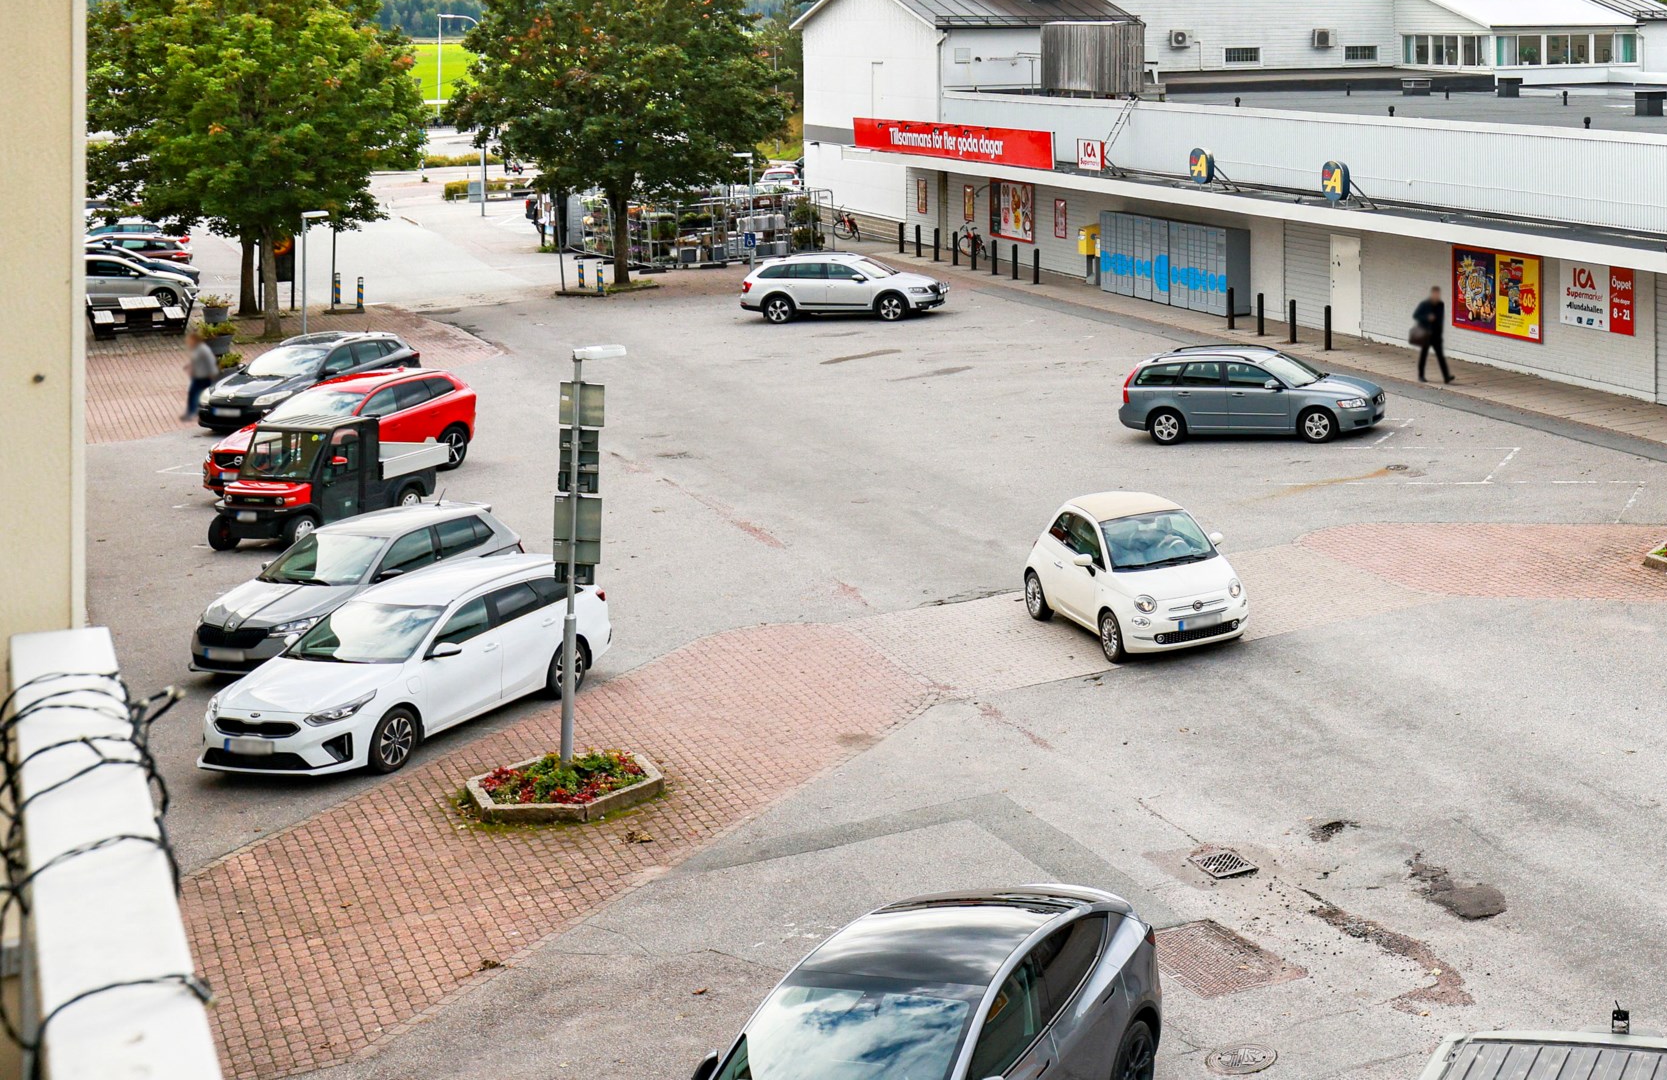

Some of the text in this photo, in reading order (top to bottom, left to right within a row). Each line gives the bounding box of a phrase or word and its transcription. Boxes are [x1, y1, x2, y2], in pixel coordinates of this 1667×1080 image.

[889, 127, 932, 149] Tillsammans
[944, 131, 956, 151] fler
[958, 133, 978, 156] goda
[980, 134, 1003, 159] dagar
[1083, 142, 1097, 158] ICA
[1573, 267, 1596, 290] ICA
[1612, 275, 1632, 291] Öppet
[1566, 287, 1603, 302] Supermarket
[1566, 301, 1604, 314] Alundahallen
[1613, 307, 1618, 319] 8
[1623, 309, 1631, 321] 21
